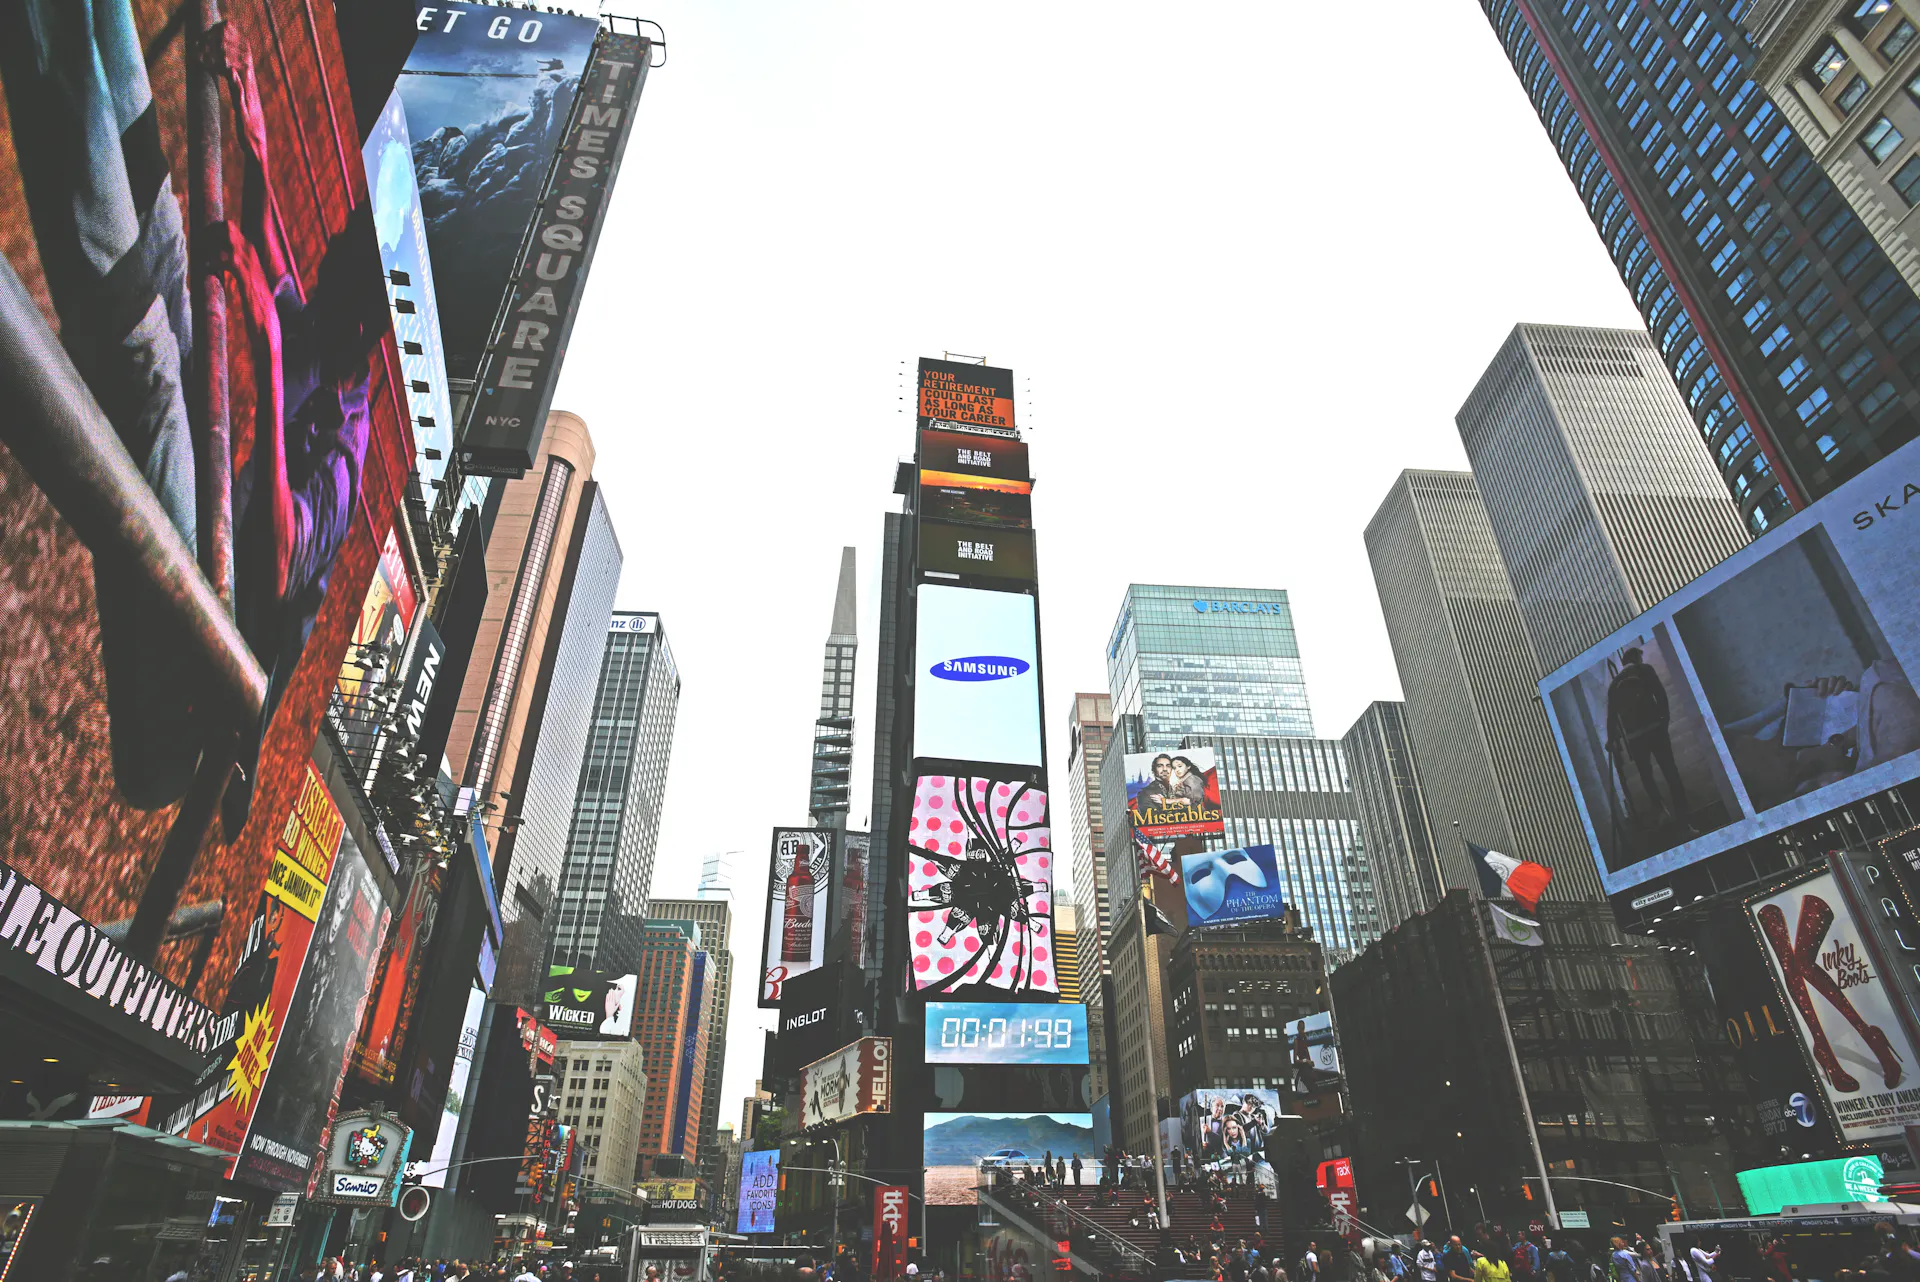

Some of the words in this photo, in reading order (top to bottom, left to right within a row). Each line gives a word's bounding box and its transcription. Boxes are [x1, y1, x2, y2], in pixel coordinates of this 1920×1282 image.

[487, 15, 543, 43] GO
[569, 59, 635, 179] TIMES
[497, 195, 588, 390] SQUARE
[924, 369, 955, 382] YOUR
[924, 379, 997, 396] RETIREMENT
[925, 389, 963, 402] COULD
[966, 394, 996, 406] LAST
[924, 398, 940, 408] AS
[944, 401, 975, 412] LONG
[978, 405, 994, 415] AS
[485, 415, 521, 428] NYC
[924, 407, 957, 419] YOUR
[960, 411, 1006, 426] CAREER
[957, 448, 971, 456] THE
[973, 450, 992, 458] BELT
[957, 454, 972, 462] AND
[957, 458, 992, 468] INITIATIVE
[957, 540, 972, 549] THE
[975, 542, 994, 551] BELT
[957, 546, 973, 554] AND
[974, 548, 994, 556] ROAD
[957, 552, 994, 562] INITIATIVE
[1211, 600, 1281, 615] BARCLAYS
[611, 620, 627, 629] nz
[943, 660, 1018, 677] SAMSUNG
[405, 642, 442, 736] NEW
[1161, 797, 1184, 812] Les
[1132, 803, 1221, 827] Misérables
[1226, 893, 1279, 909] PHANTOM
[1647, 890, 1670, 902] outdoor
[1836, 957, 1877, 991] Boots
[786, 1007, 827, 1031] INGLOT
[1726, 1004, 1785, 1050] OIL
[252, 1020, 268, 1053] NO
[941, 1017, 1072, 1049] 00:01:99
[237, 1038, 261, 1088] JOKE!
[871, 1040, 888, 1110] HELLO!
[1784, 1106, 1797, 1118] abc
[1833, 1097, 1869, 1115] WINNER!
[1866, 1095, 1875, 1108] 6
[1873, 1092, 1896, 1108] TONY
[1839, 1110, 1874, 1122] INCLUDING
[1874, 1106, 1896, 1116] BEST
[250, 1133, 264, 1151] NOW
[263, 1140, 288, 1162] THROUGH
[752, 1174, 774, 1189] ADD
[746, 1188, 777, 1200] FAVORITE
[661, 1199, 678, 1210] HOT
[676, 1199, 698, 1210] DOGS
[749, 1200, 774, 1211] ICONS!
[881, 1189, 904, 1235] tkts
